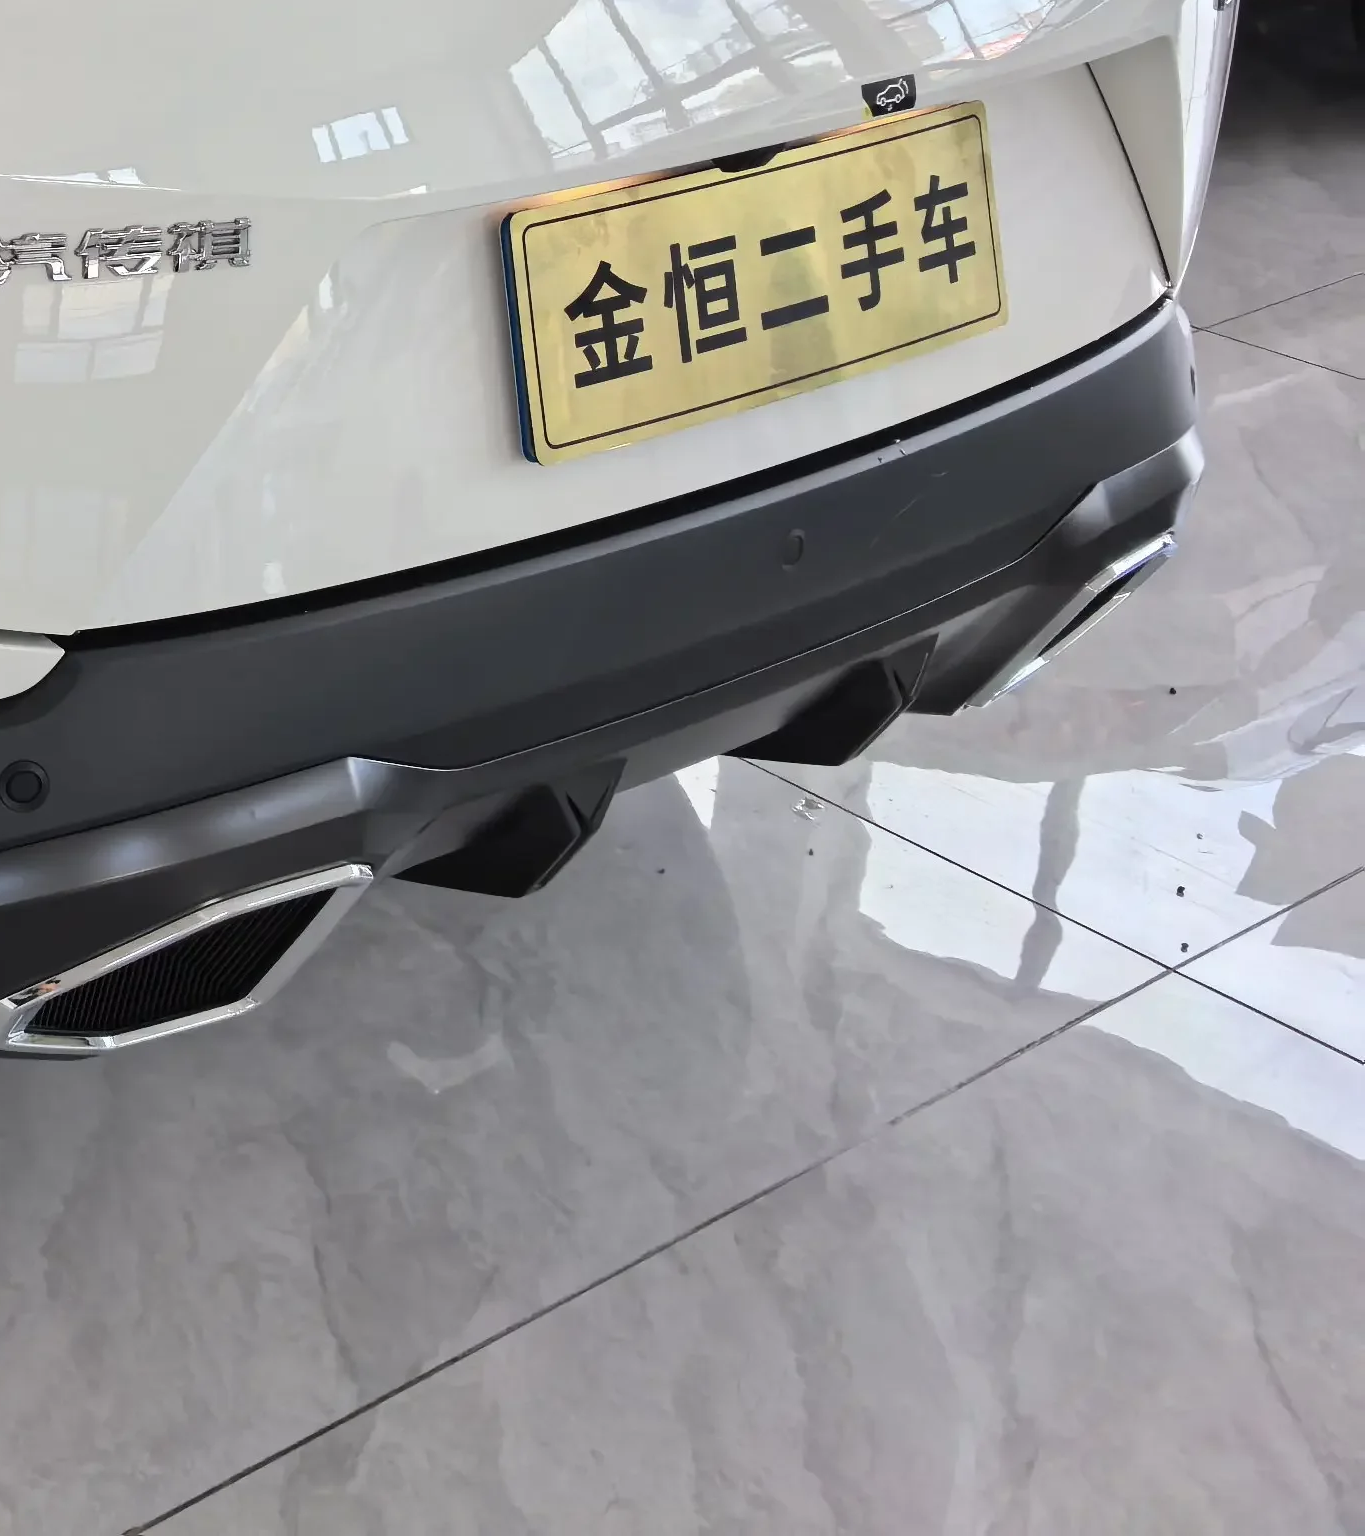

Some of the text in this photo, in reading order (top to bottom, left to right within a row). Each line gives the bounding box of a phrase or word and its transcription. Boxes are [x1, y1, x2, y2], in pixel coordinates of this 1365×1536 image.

[563, 173, 977, 389] 金恒二手车
